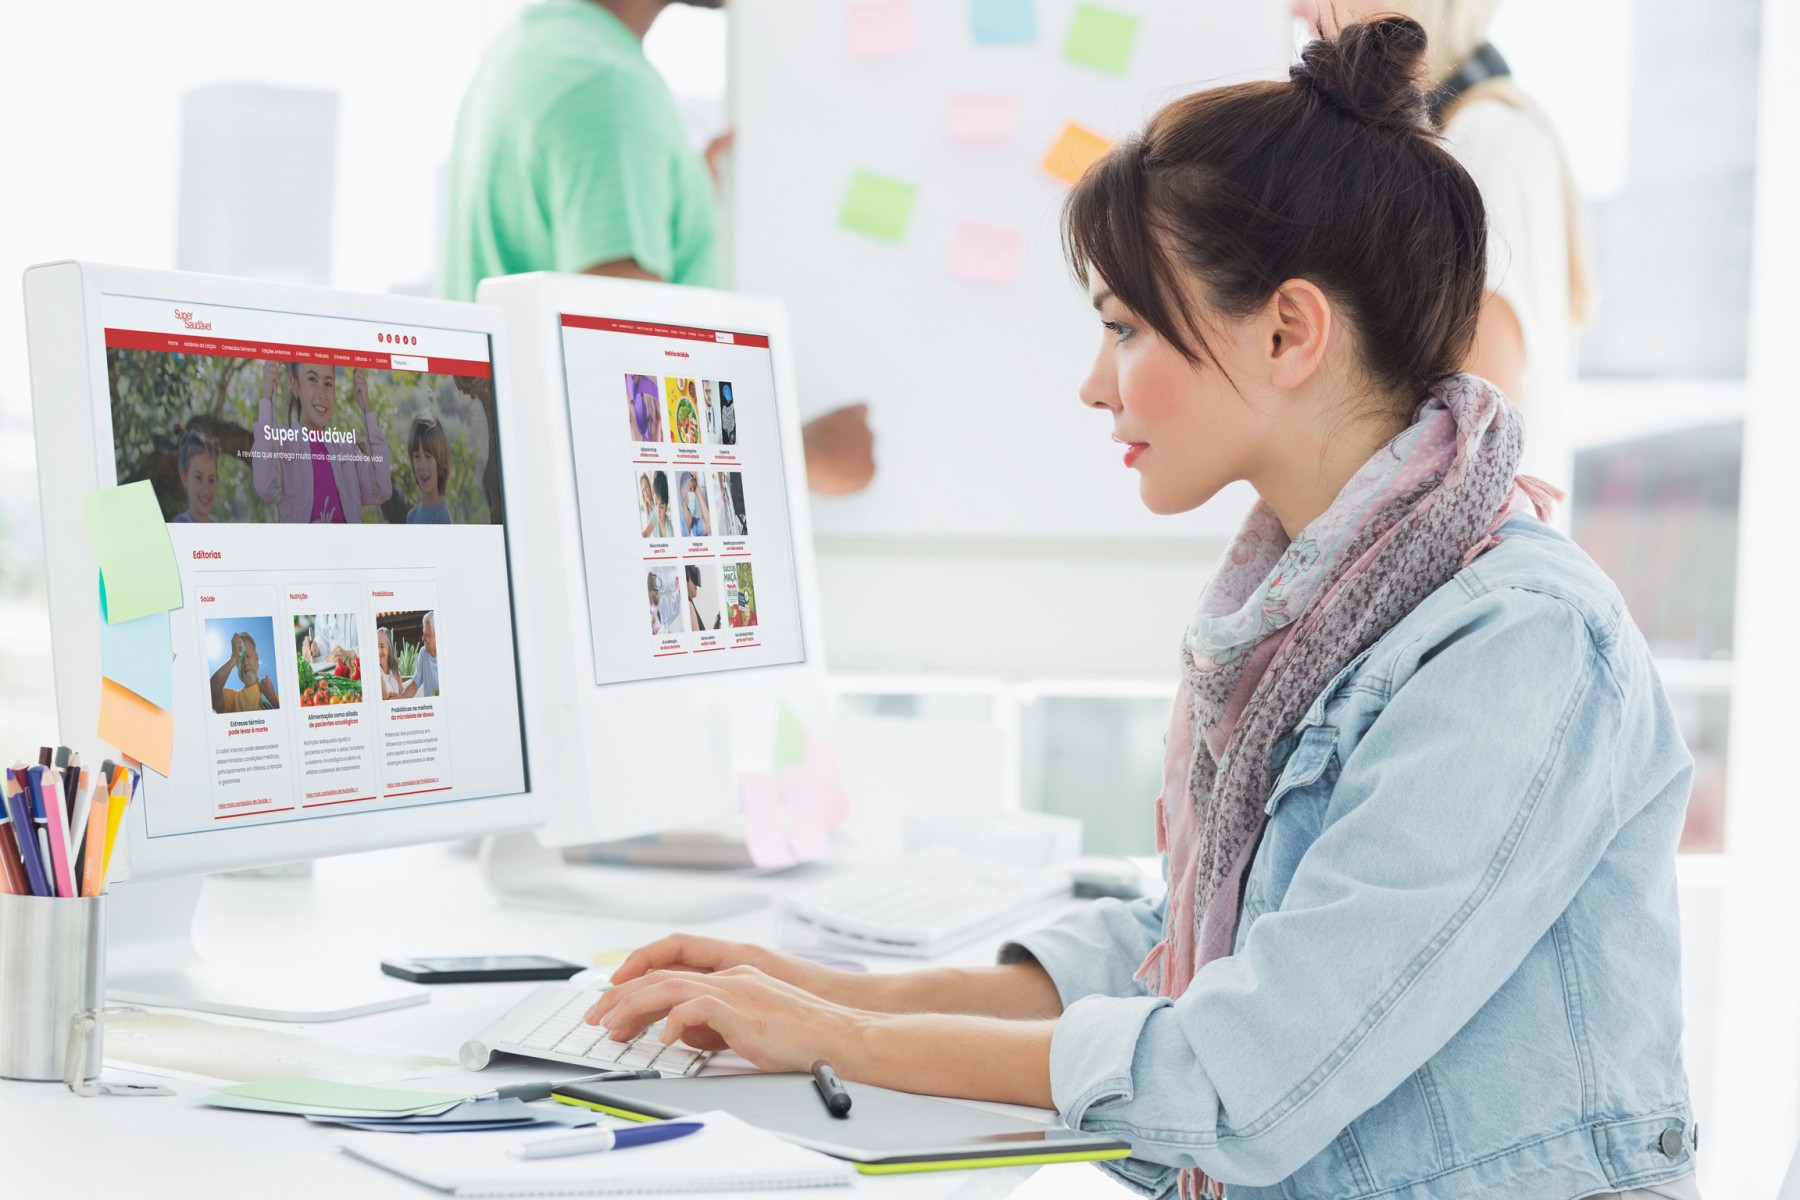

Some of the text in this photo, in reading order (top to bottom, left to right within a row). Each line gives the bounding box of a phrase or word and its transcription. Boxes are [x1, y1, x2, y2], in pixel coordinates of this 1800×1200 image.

[175, 309, 193, 321] Super
[184, 320, 212, 331] Saudável
[263, 425, 357, 446] Super Saudável
[242, 450, 261, 458] revista
[261, 452, 273, 460] que
[273, 452, 295, 462] entrega
[295, 452, 311, 460] muito
[326, 454, 336, 462] que
[337, 453, 363, 463] qualidade
[363, 454, 370, 462] de
[192, 550, 222, 560] Editorias
[200, 595, 216, 603] Saúde
[289, 592, 308, 601] Nutrição
[315, 720, 334, 729] pacientes
[228, 729, 240, 737] pode
